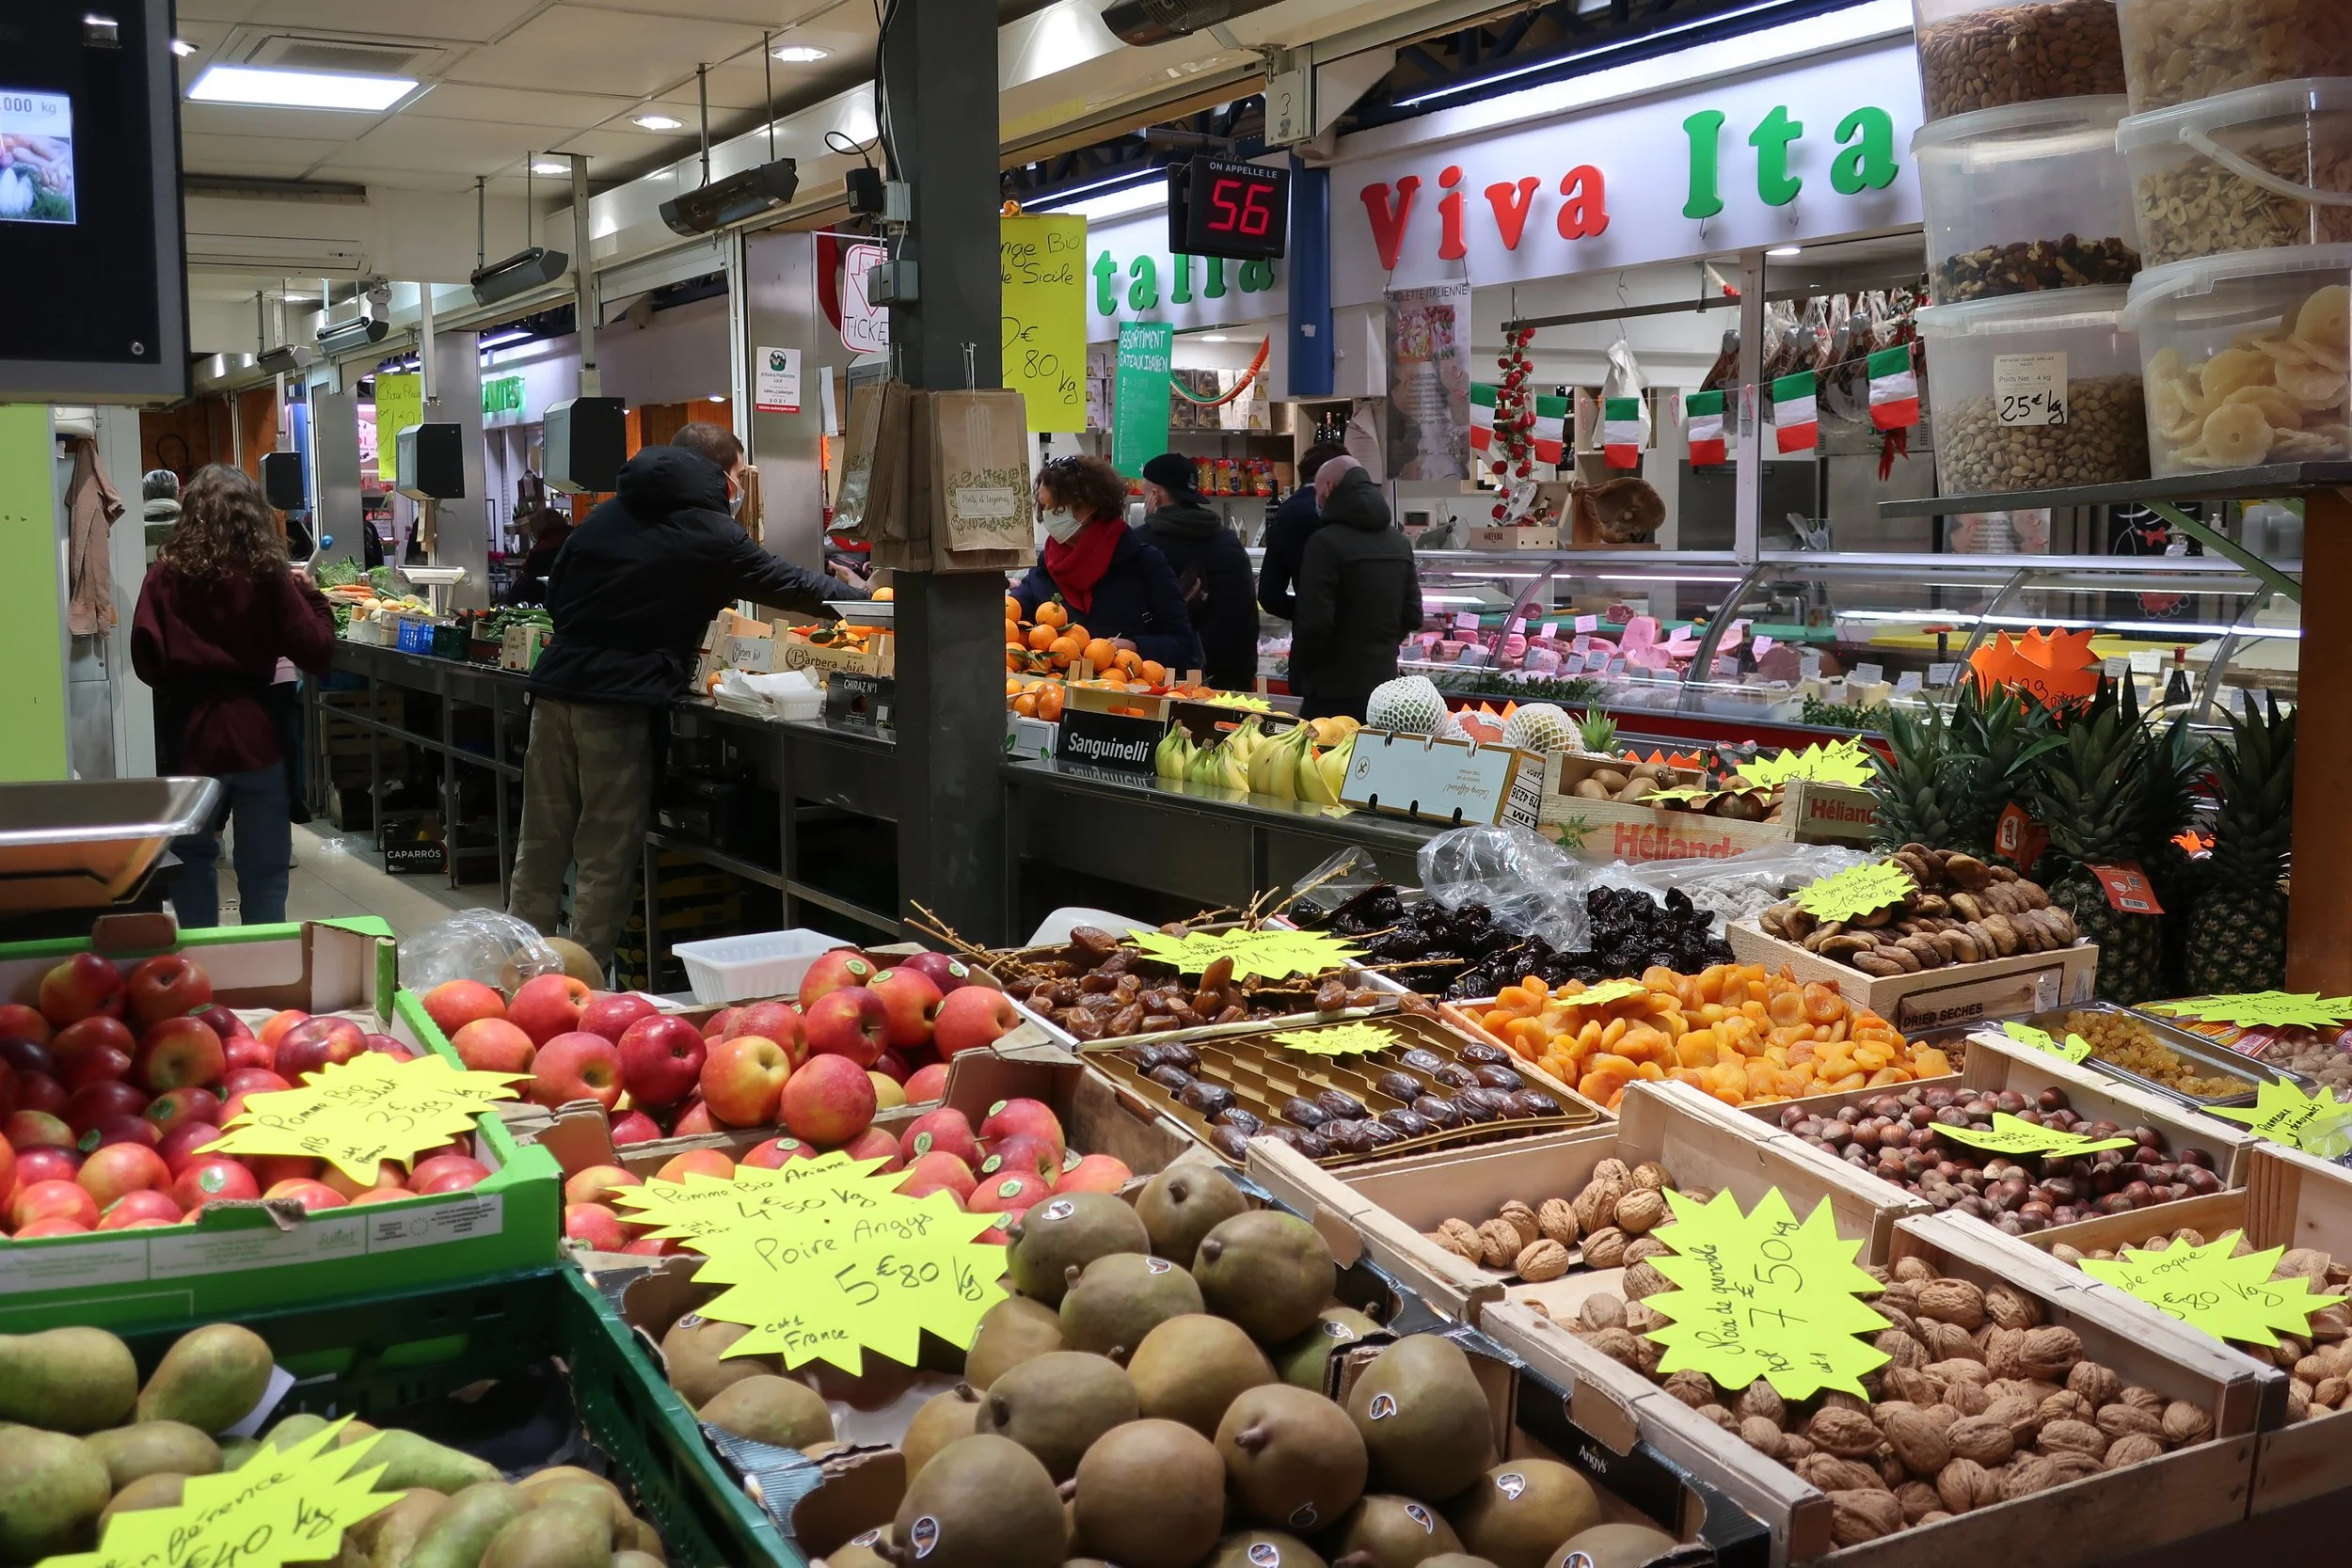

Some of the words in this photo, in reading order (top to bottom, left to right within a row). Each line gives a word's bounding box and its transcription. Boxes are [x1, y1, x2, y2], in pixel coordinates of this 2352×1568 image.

[41, 101, 56, 115] kg
[1280, 93, 1292, 116] 3
[1210, 162, 1223, 171] ON
[1225, 164, 1264, 177] APPELLE
[1266, 170, 1278, 179] LE
[1360, 165, 1610, 271] Viva
[1682, 105, 1899, 219] Ita
[1207, 179, 1275, 235] 56
[1047, 232, 1080, 253] Bio
[1023, 263, 1074, 286] Sicile
[1426, 284, 1468, 299] ITALIENNE
[789, 649, 837, 669] Barbera
[843, 678, 866, 694] CHIRAZ
[1068, 731, 1150, 763] Sanguinelli
[1510, 786, 1529, 803] 4236
[387, 847, 441, 859] CAPARRÓS
[1939, 1002, 1984, 1022] SECHES
[300, 1135, 330, 1154] AB
[652, 1187, 729, 1205] Pomme
[733, 1180, 774, 1194] Bio
[754, 1235, 837, 1272] Poire
[853, 1212, 934, 1243] Angys
[783, 1325, 850, 1353] France
[1579, 1445, 1607, 1474] Angys
